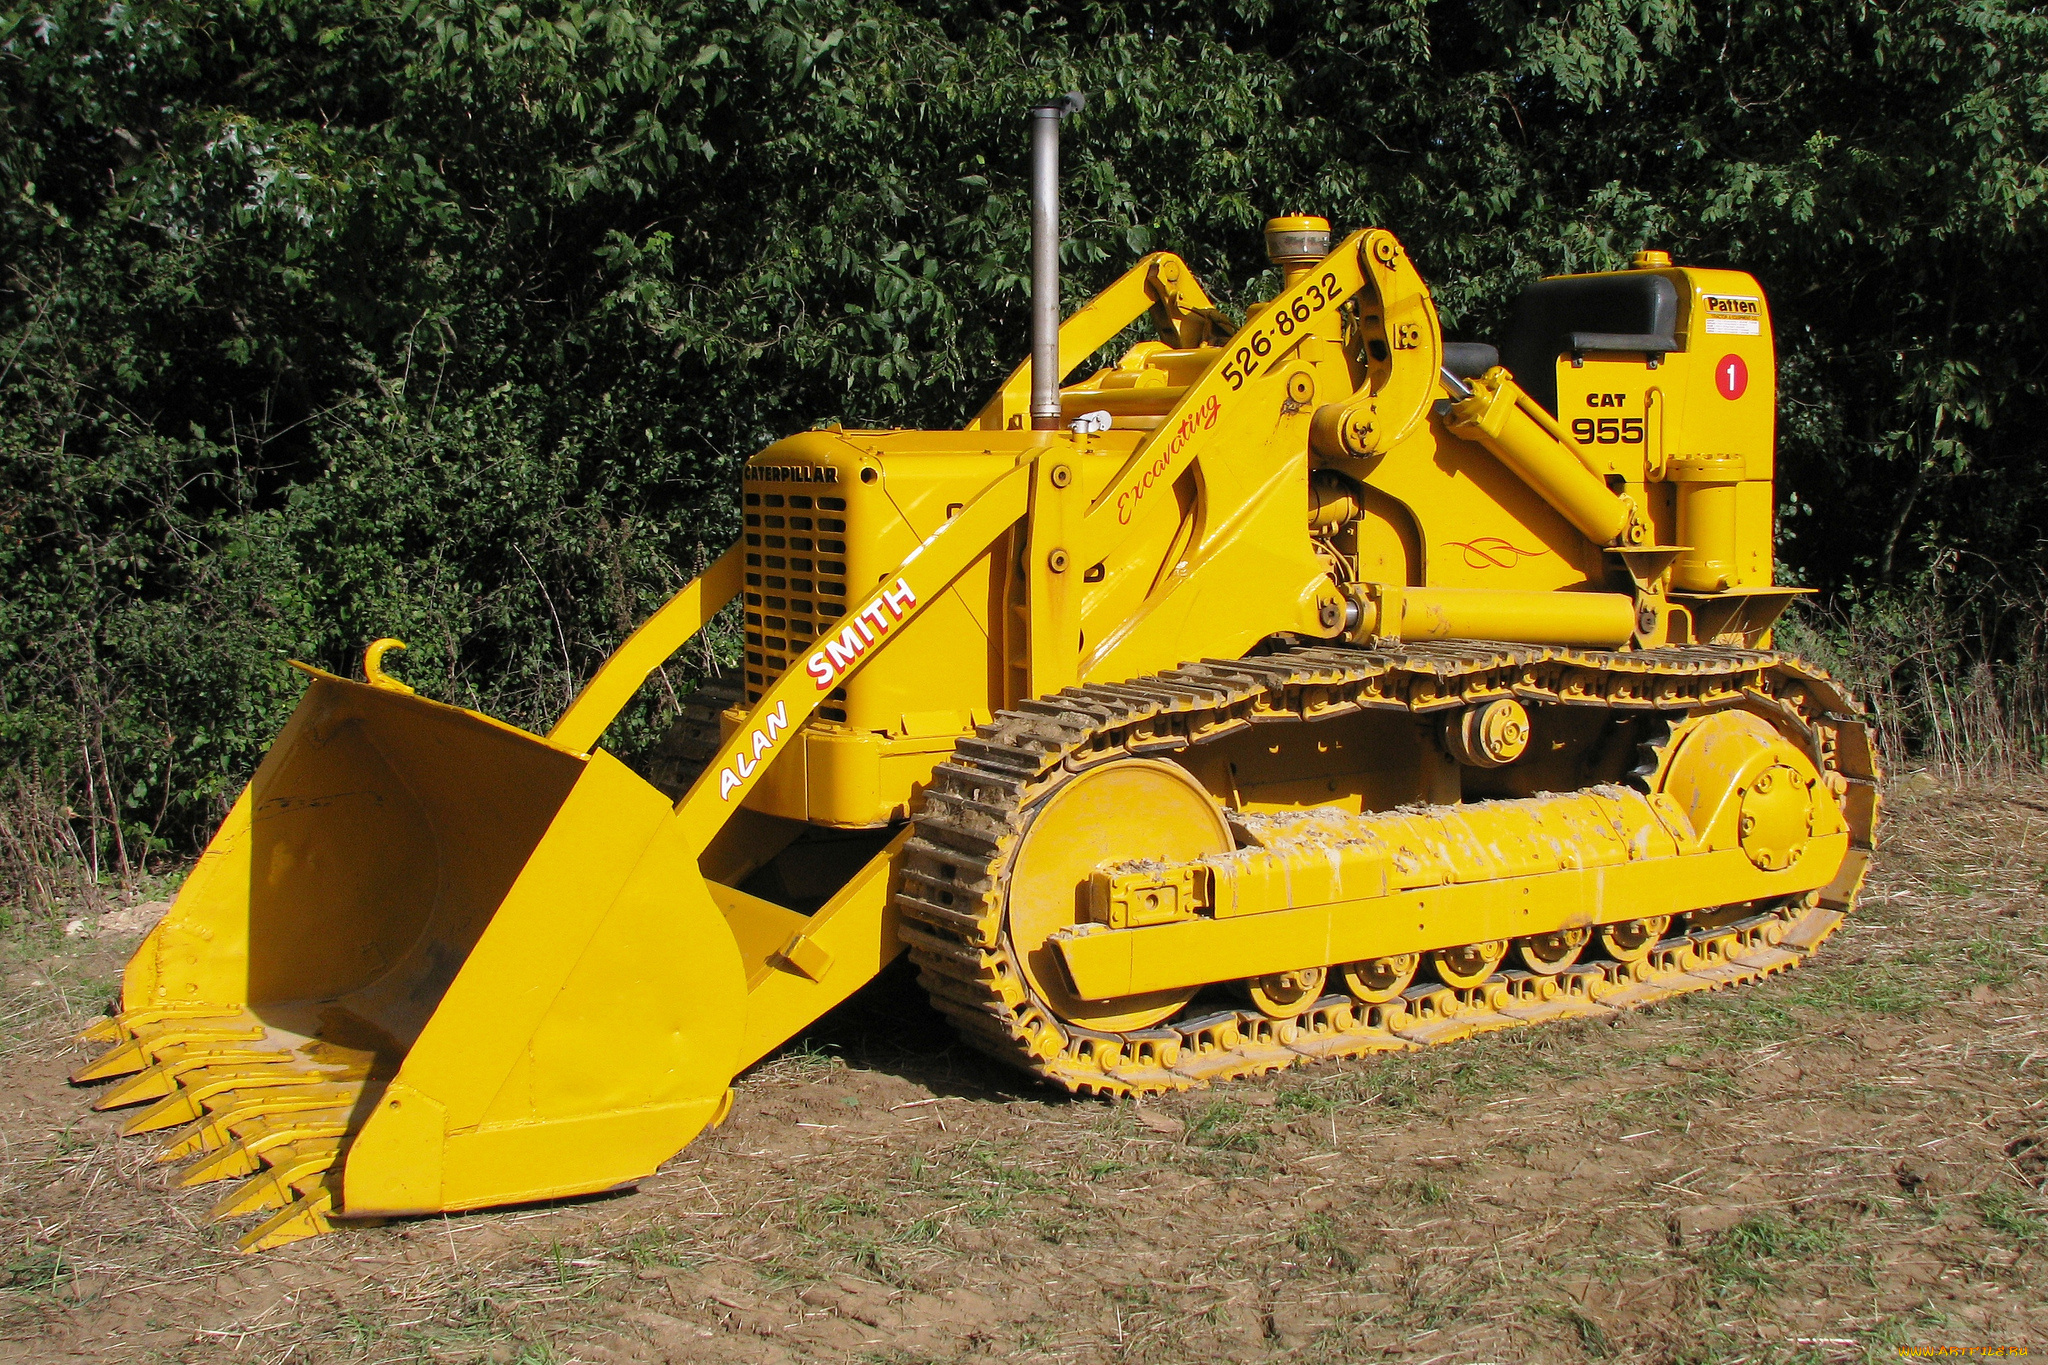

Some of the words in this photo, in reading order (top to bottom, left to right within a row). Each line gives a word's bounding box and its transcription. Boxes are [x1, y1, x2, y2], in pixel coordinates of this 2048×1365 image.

[1707, 297, 1757, 313] Patten
[1221, 272, 1343, 392] 526-8632
[1727, 364, 1735, 391] 1
[1586, 393, 1626, 408] CAT
[1571, 418, 1644, 444] 955
[1117, 394, 1222, 526] Excavating
[744, 465, 838, 482] CATERPILLAR
[720, 700, 788, 801] ALAN
[806, 577, 916, 690] SMITH
